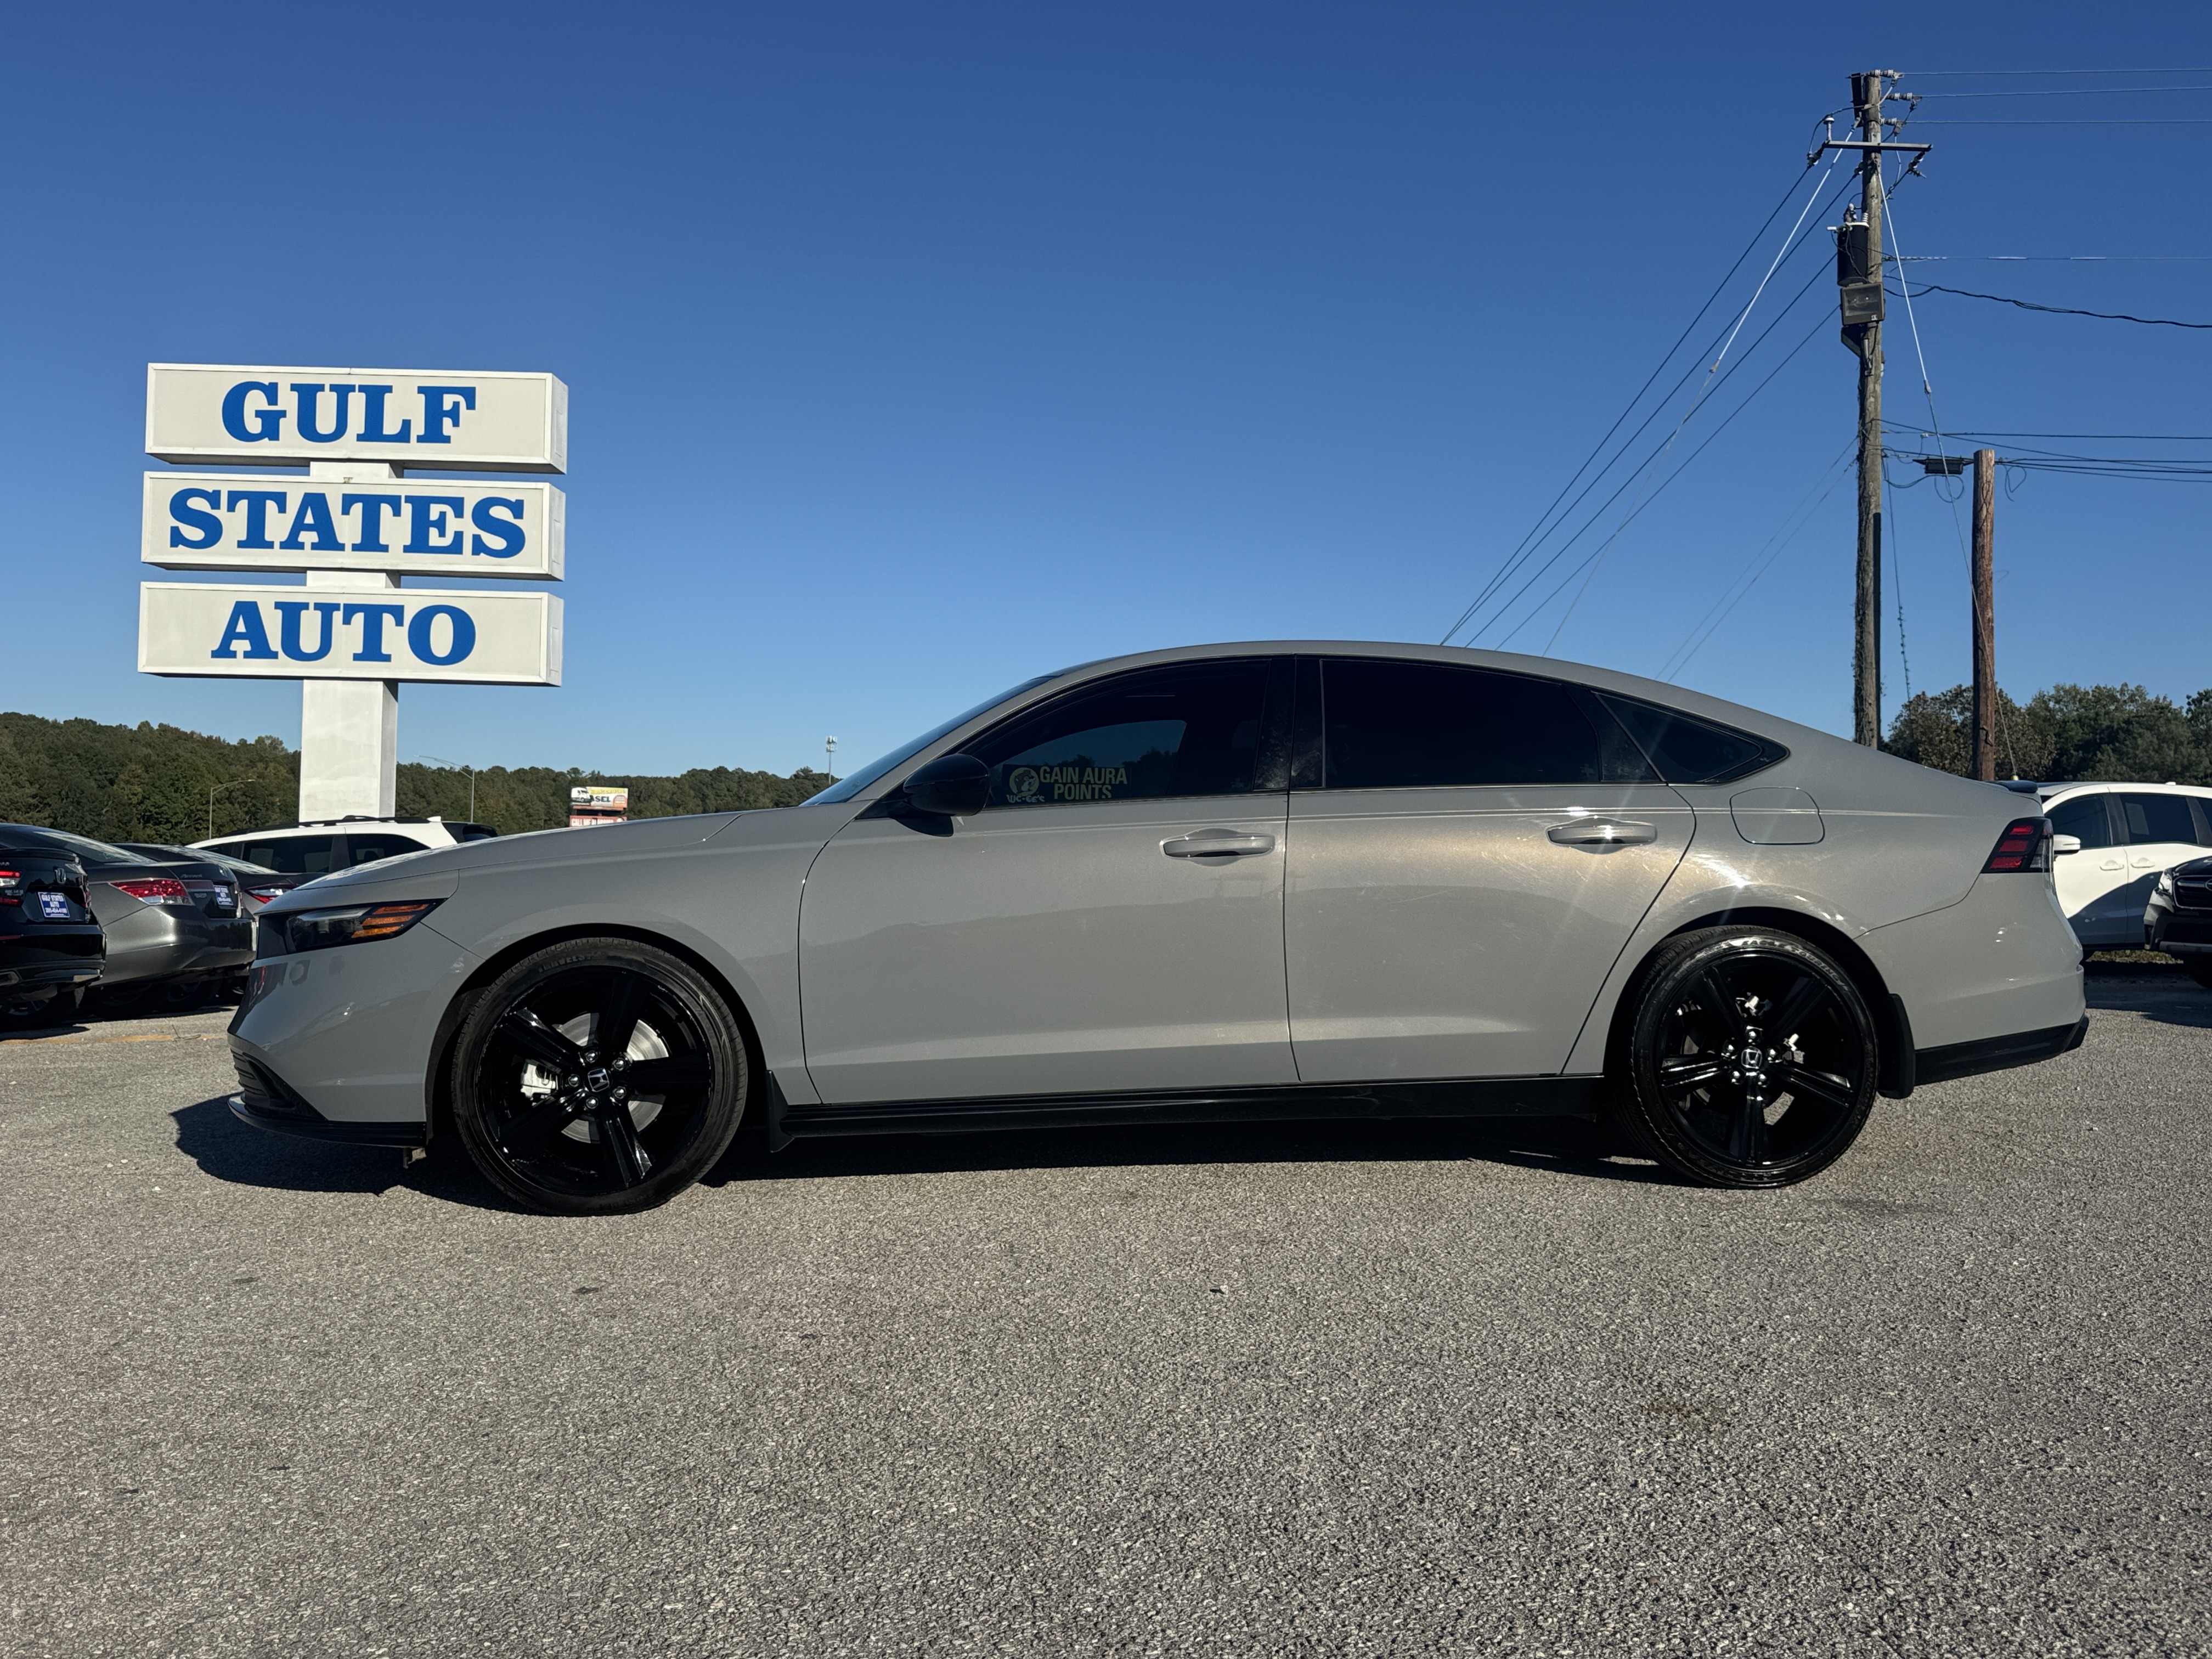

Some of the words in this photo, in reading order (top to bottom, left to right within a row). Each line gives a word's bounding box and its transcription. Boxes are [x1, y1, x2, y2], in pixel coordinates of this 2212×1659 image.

[222, 381, 476, 444] GULF
[169, 488, 526, 558] STATES
[211, 601, 476, 665] AUTO
[1040, 766, 1079, 783] GAIN
[1082, 767, 1127, 784] AURA
[1054, 783, 1111, 800] POINTS
